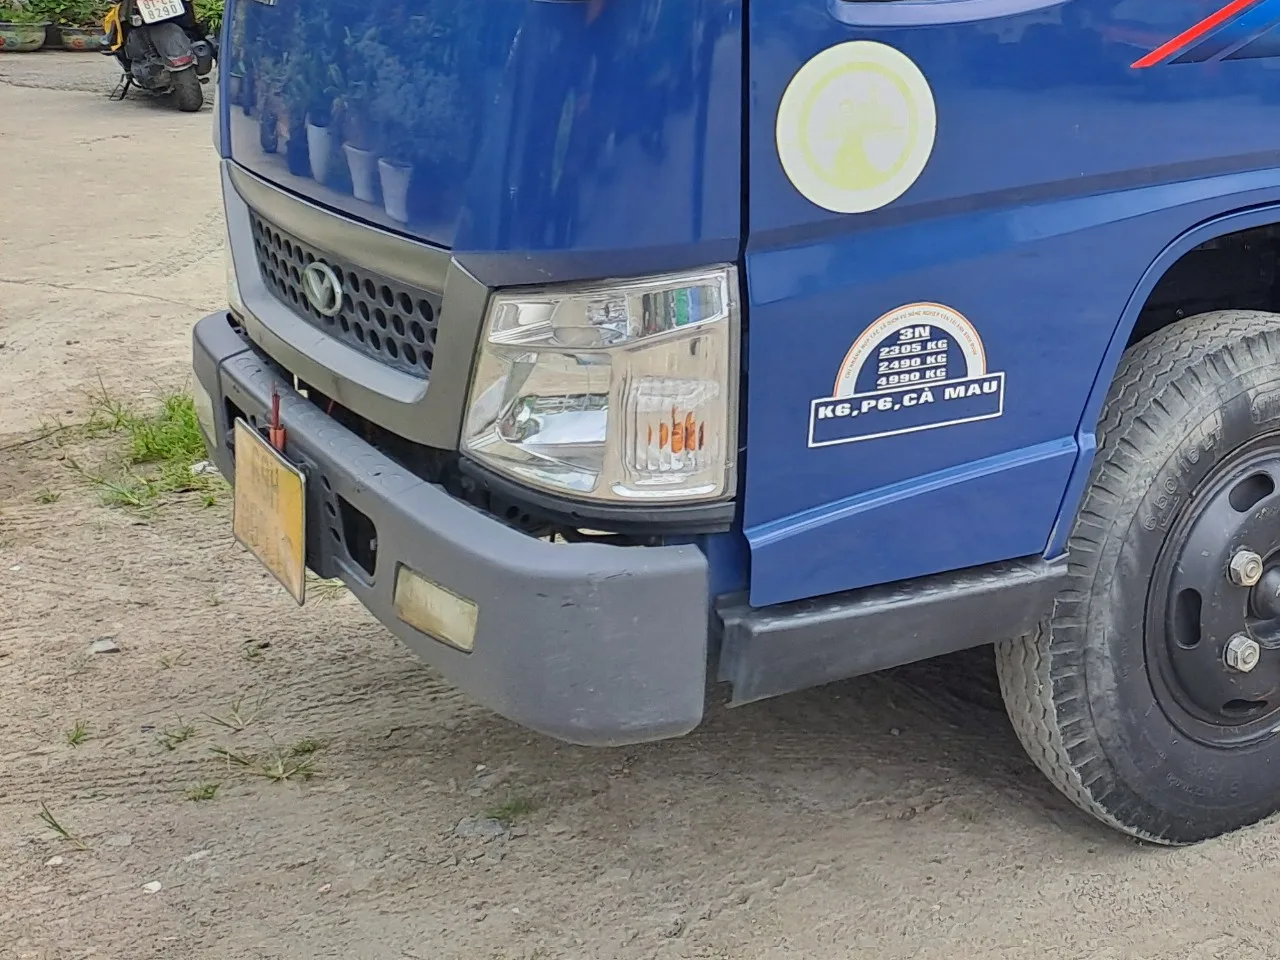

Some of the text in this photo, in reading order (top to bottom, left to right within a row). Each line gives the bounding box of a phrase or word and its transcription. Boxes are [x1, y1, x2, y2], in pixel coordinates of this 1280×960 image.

[899, 326, 930, 340] 3N
[879, 339, 948, 357] 2305 KG
[878, 353, 948, 372] 2490 KG
[876, 367, 947, 386] 4990 KG
[943, 380, 999, 401] MAU
